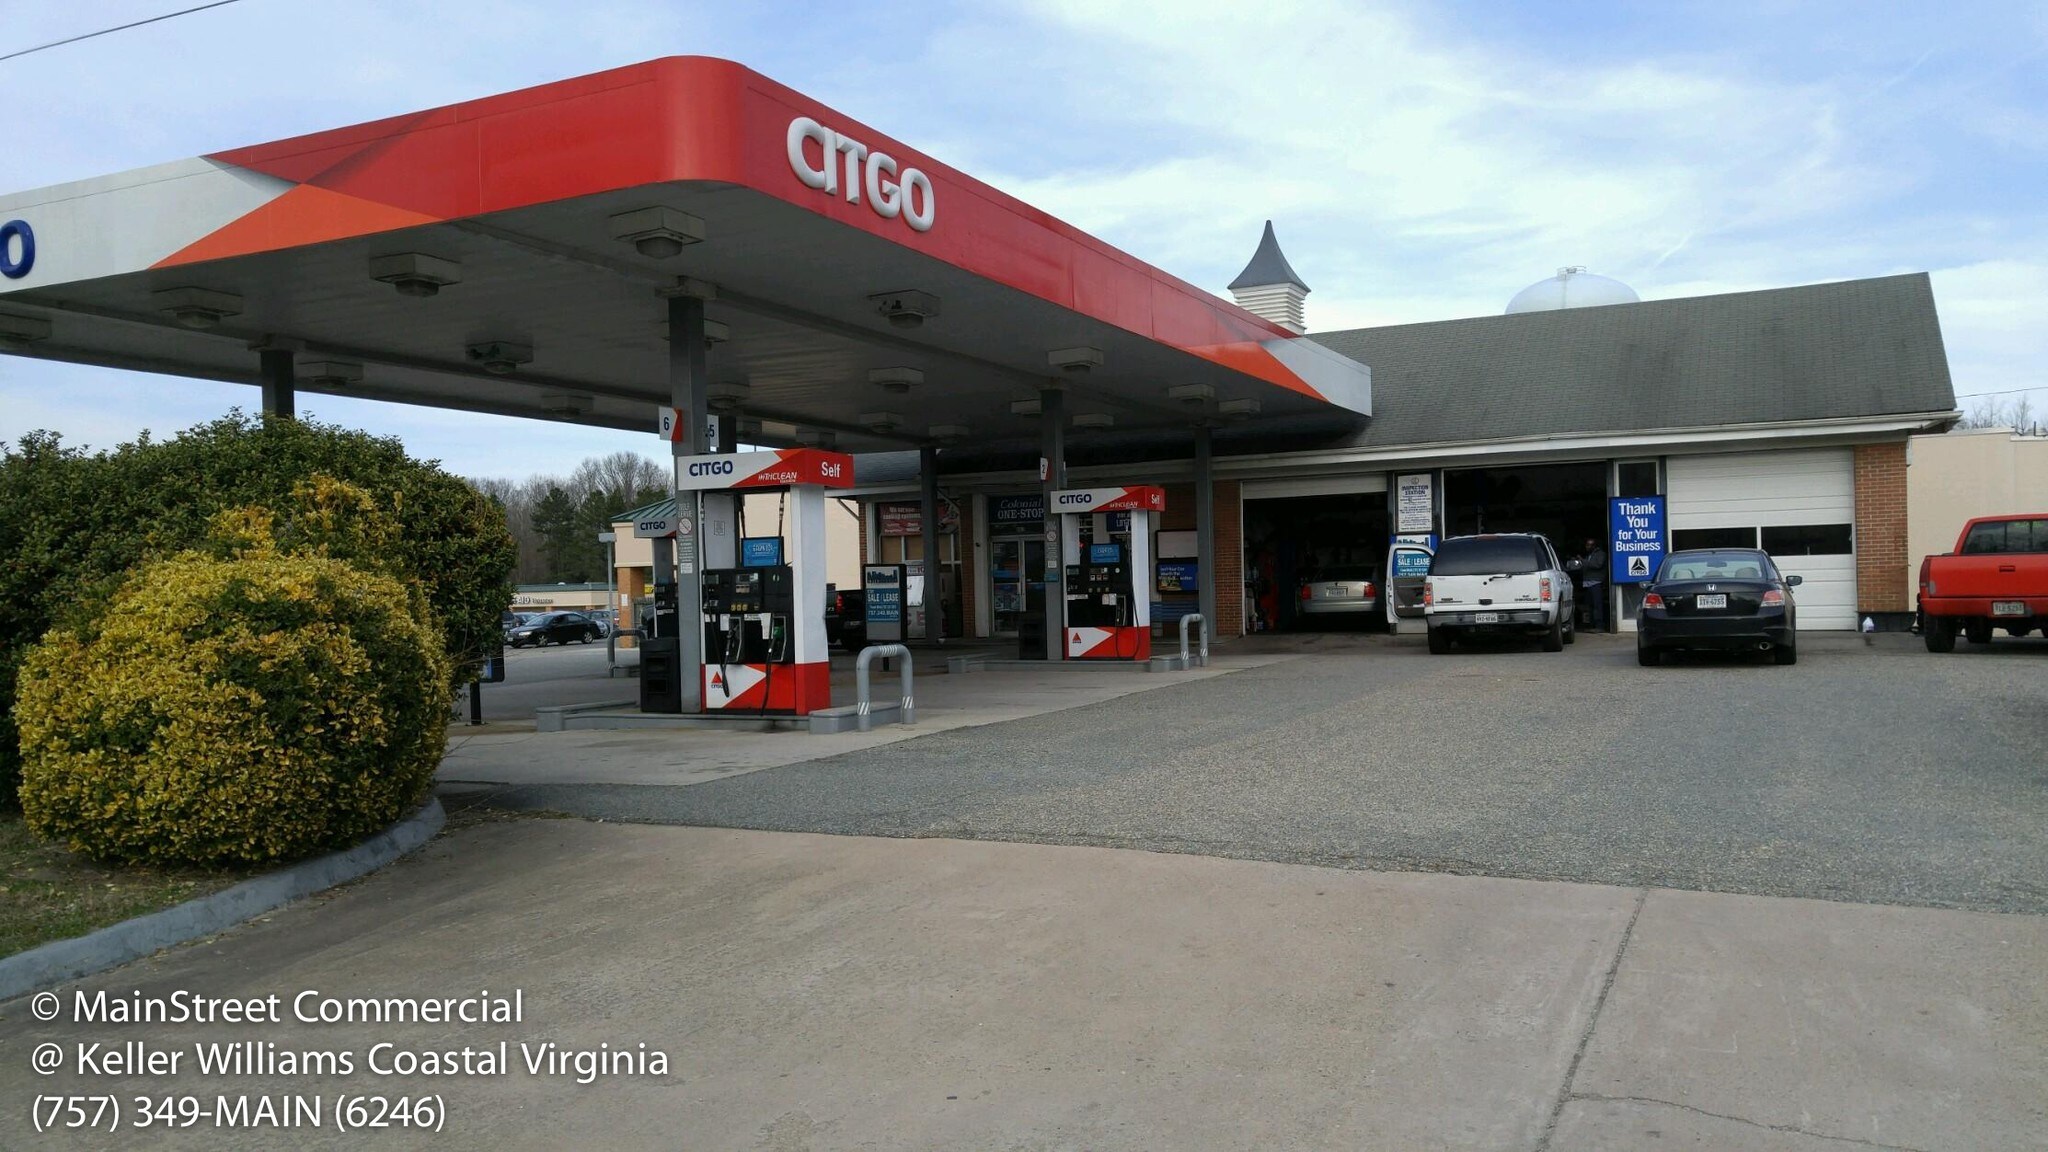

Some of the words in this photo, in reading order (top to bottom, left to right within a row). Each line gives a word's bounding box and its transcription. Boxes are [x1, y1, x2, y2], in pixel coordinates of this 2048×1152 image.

[787, 117, 935, 232] CITGO
[663, 416, 670, 431] 6
[709, 424, 715, 437] 5
[689, 460, 734, 477] CITGO
[821, 461, 841, 478] Self
[1000, 498, 1043, 509] Colonial
[1059, 494, 1092, 505] CITGO
[997, 508, 1045, 519] ONE-STOP
[1618, 502, 1656, 515] Thank
[640, 521, 666, 531] CITGO
[1627, 516, 1648, 528] You
[1618, 529, 1633, 540] for
[1635, 529, 1658, 540] Your
[1616, 540, 1661, 552] Business
[1398, 558, 1411, 566] SALE
[1414, 558, 1430, 566] LEASE
[867, 593, 880, 602] SALE
[883, 593, 899, 602] LEASE
